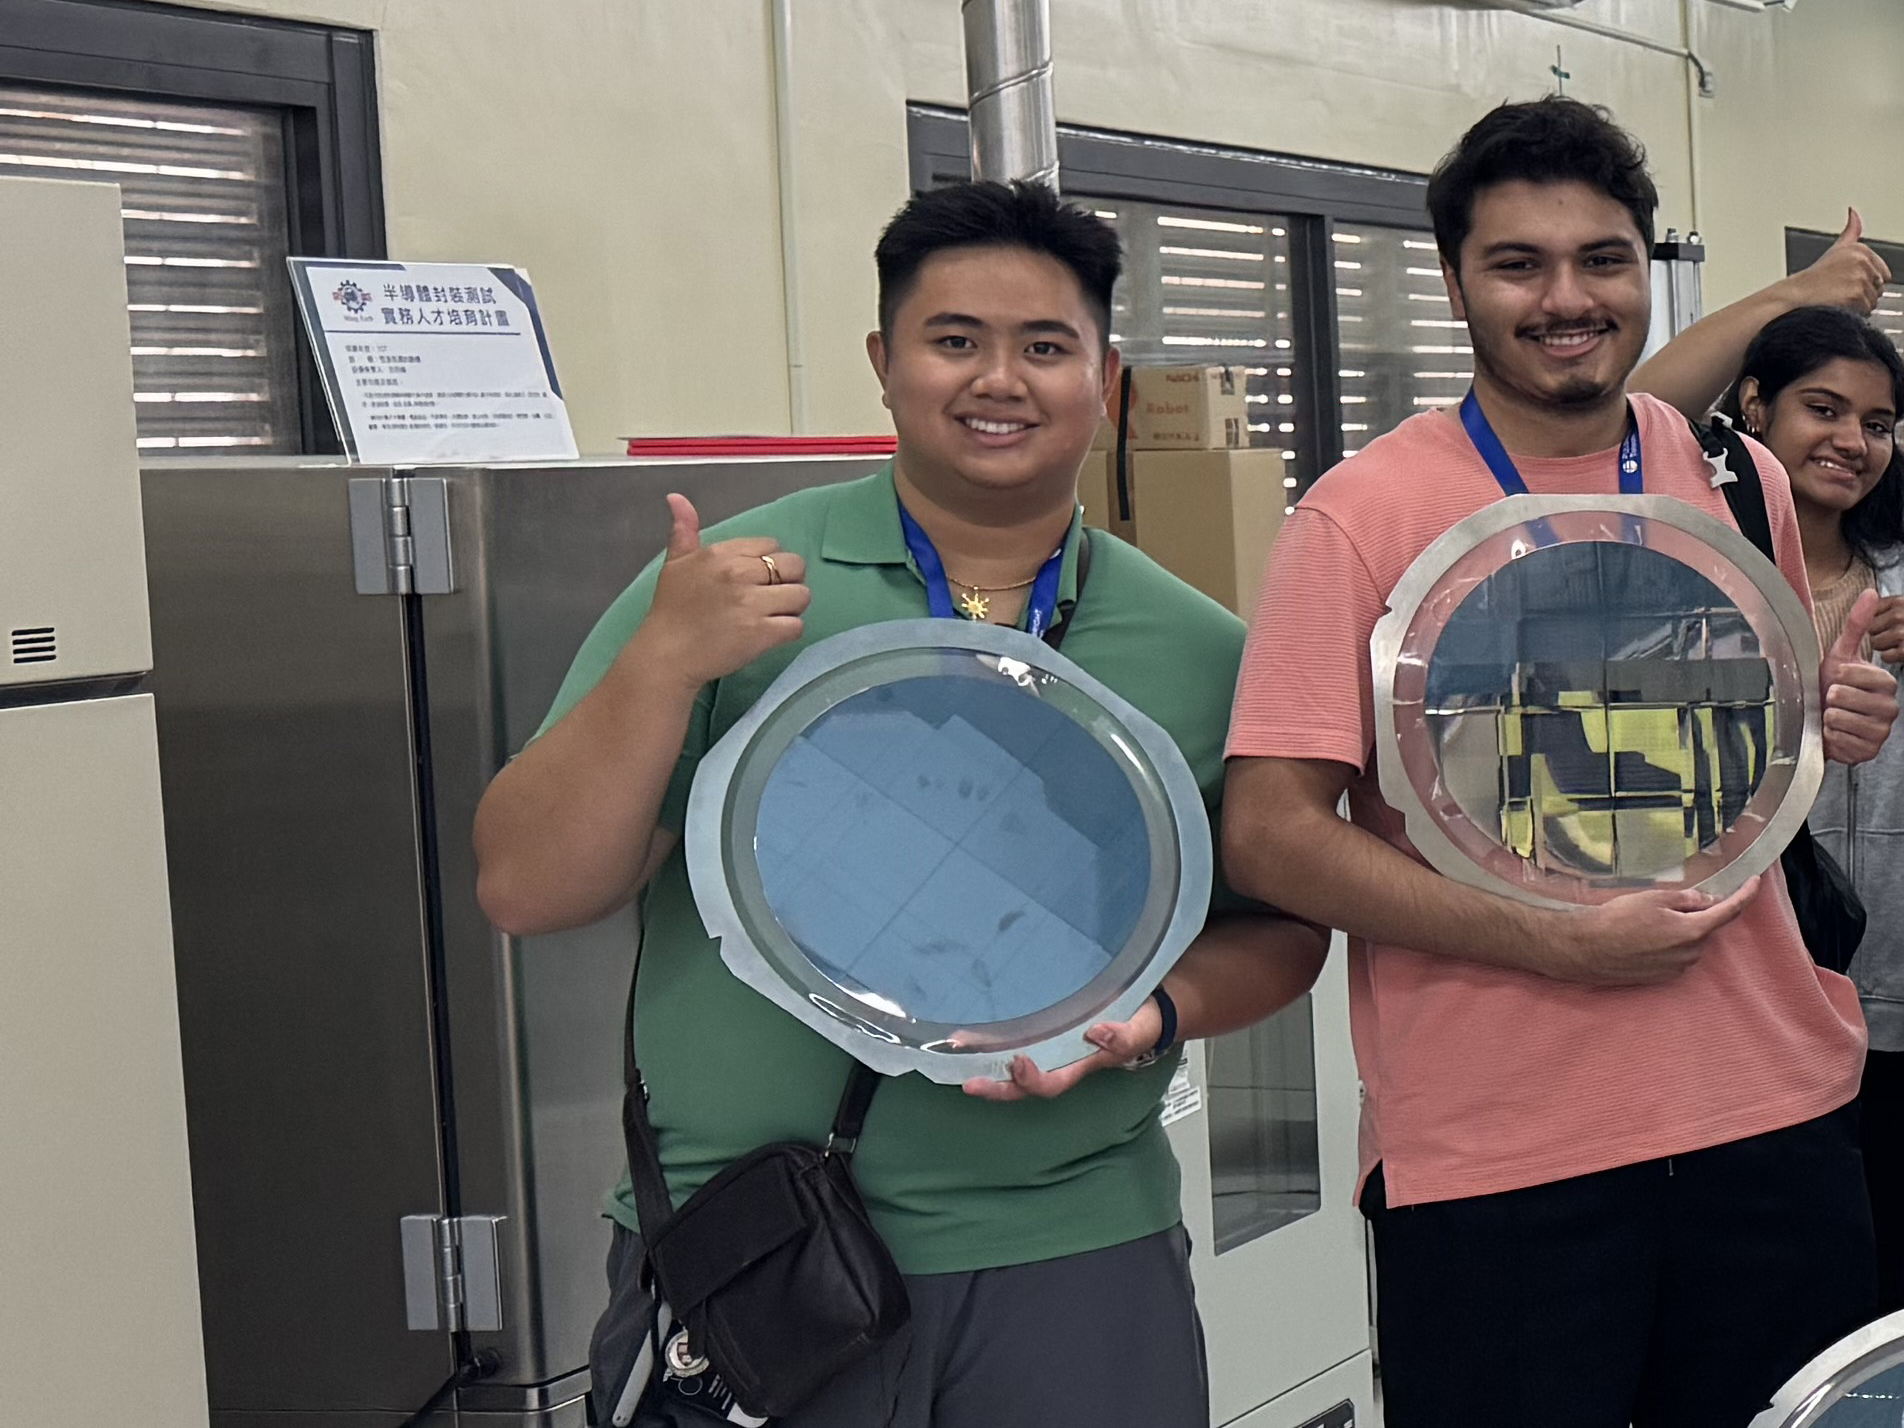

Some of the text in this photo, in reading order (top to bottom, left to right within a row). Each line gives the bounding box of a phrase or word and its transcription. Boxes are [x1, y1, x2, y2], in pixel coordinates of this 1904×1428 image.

[382, 283, 497, 306] 半導體封裝測試
[380, 307, 511, 327] 實務人才培育計畫
